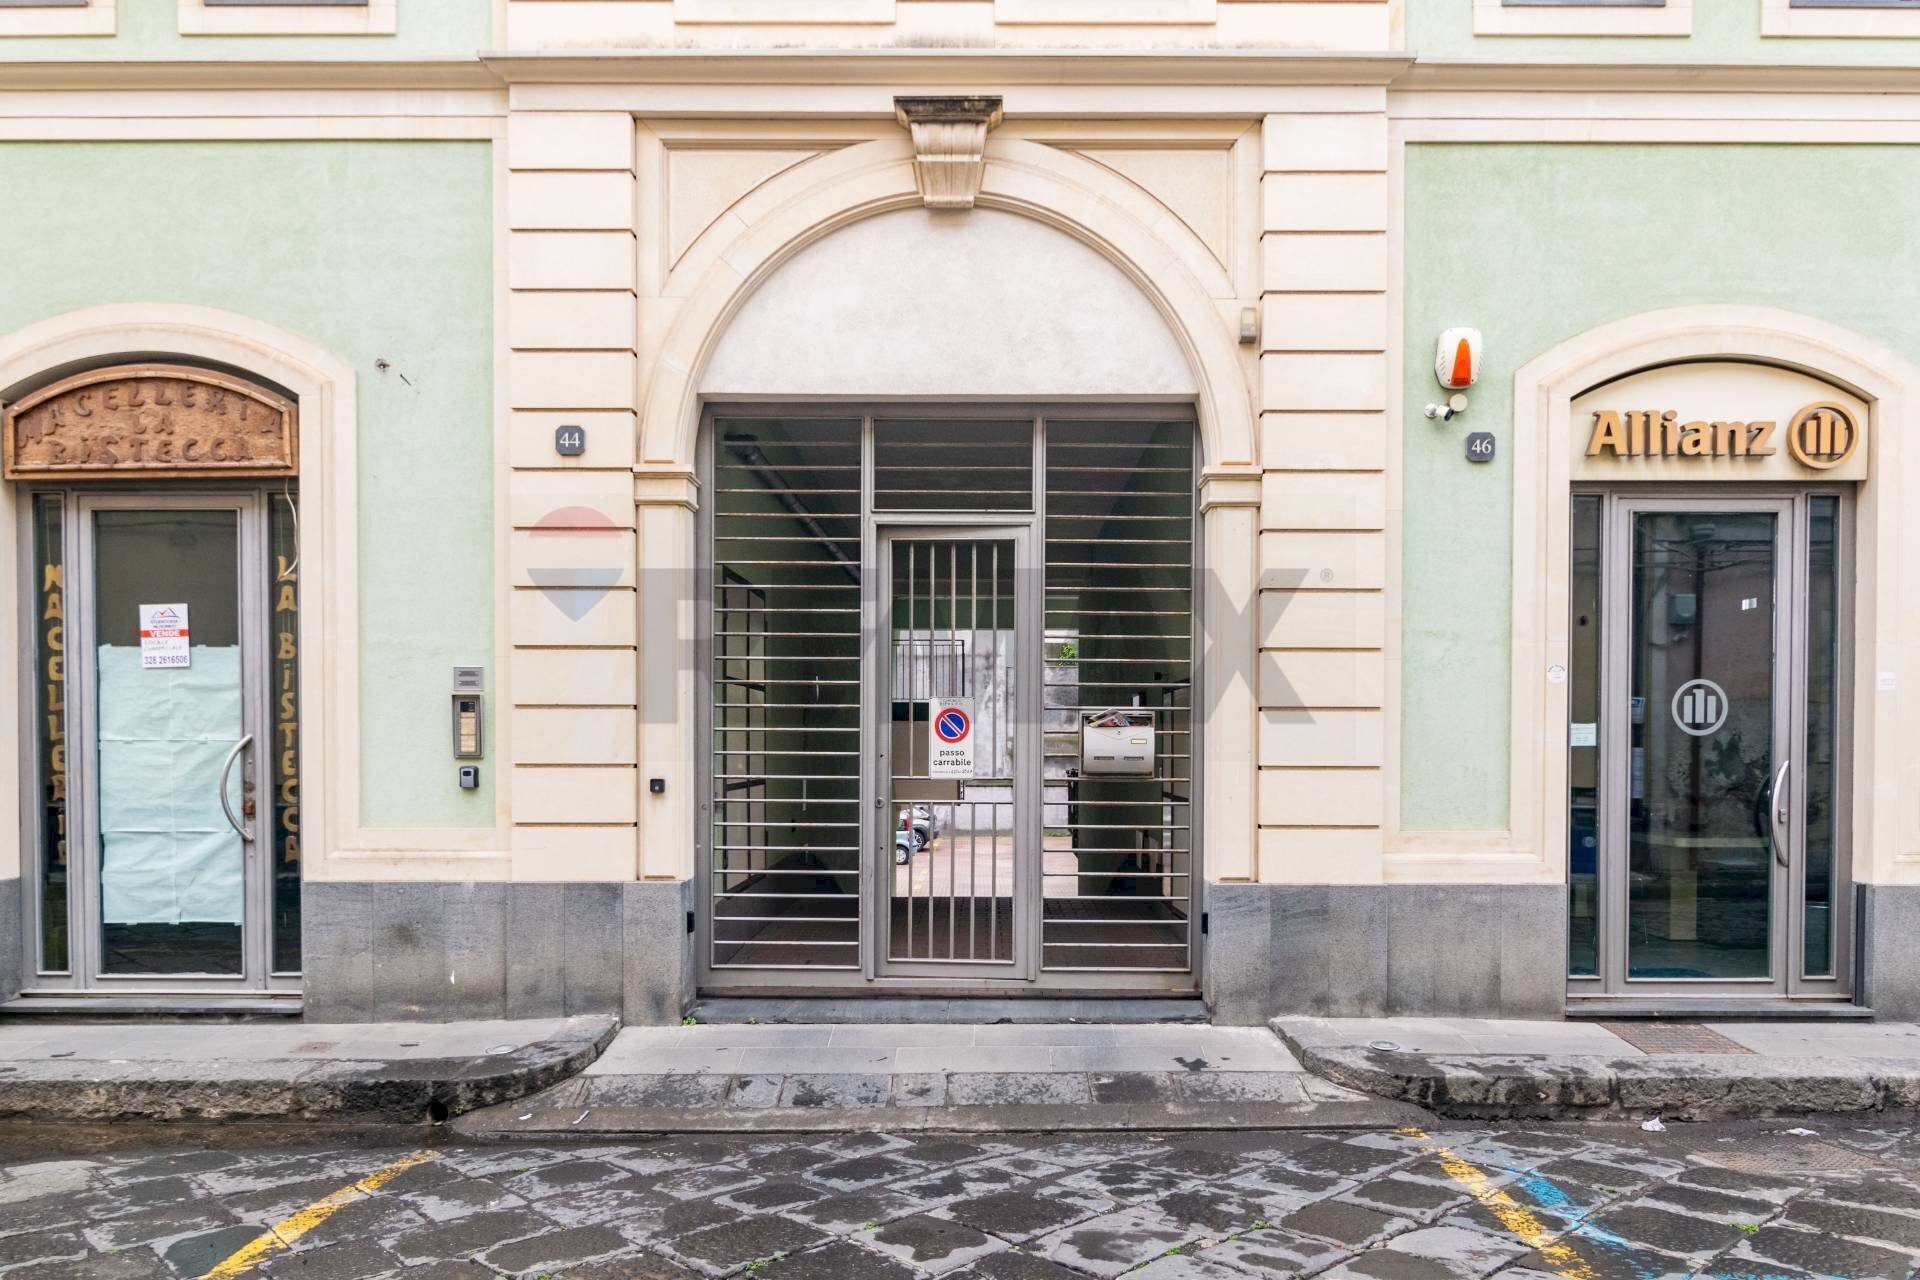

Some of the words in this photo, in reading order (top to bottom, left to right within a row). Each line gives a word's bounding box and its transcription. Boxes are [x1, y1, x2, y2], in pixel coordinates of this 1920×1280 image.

[131, 413, 174, 435] LA
[559, 431, 580, 448] 44
[1585, 409, 1776, 457] Allianz
[1471, 438, 1492, 454] 46
[150, 630, 180, 638] VENDE
